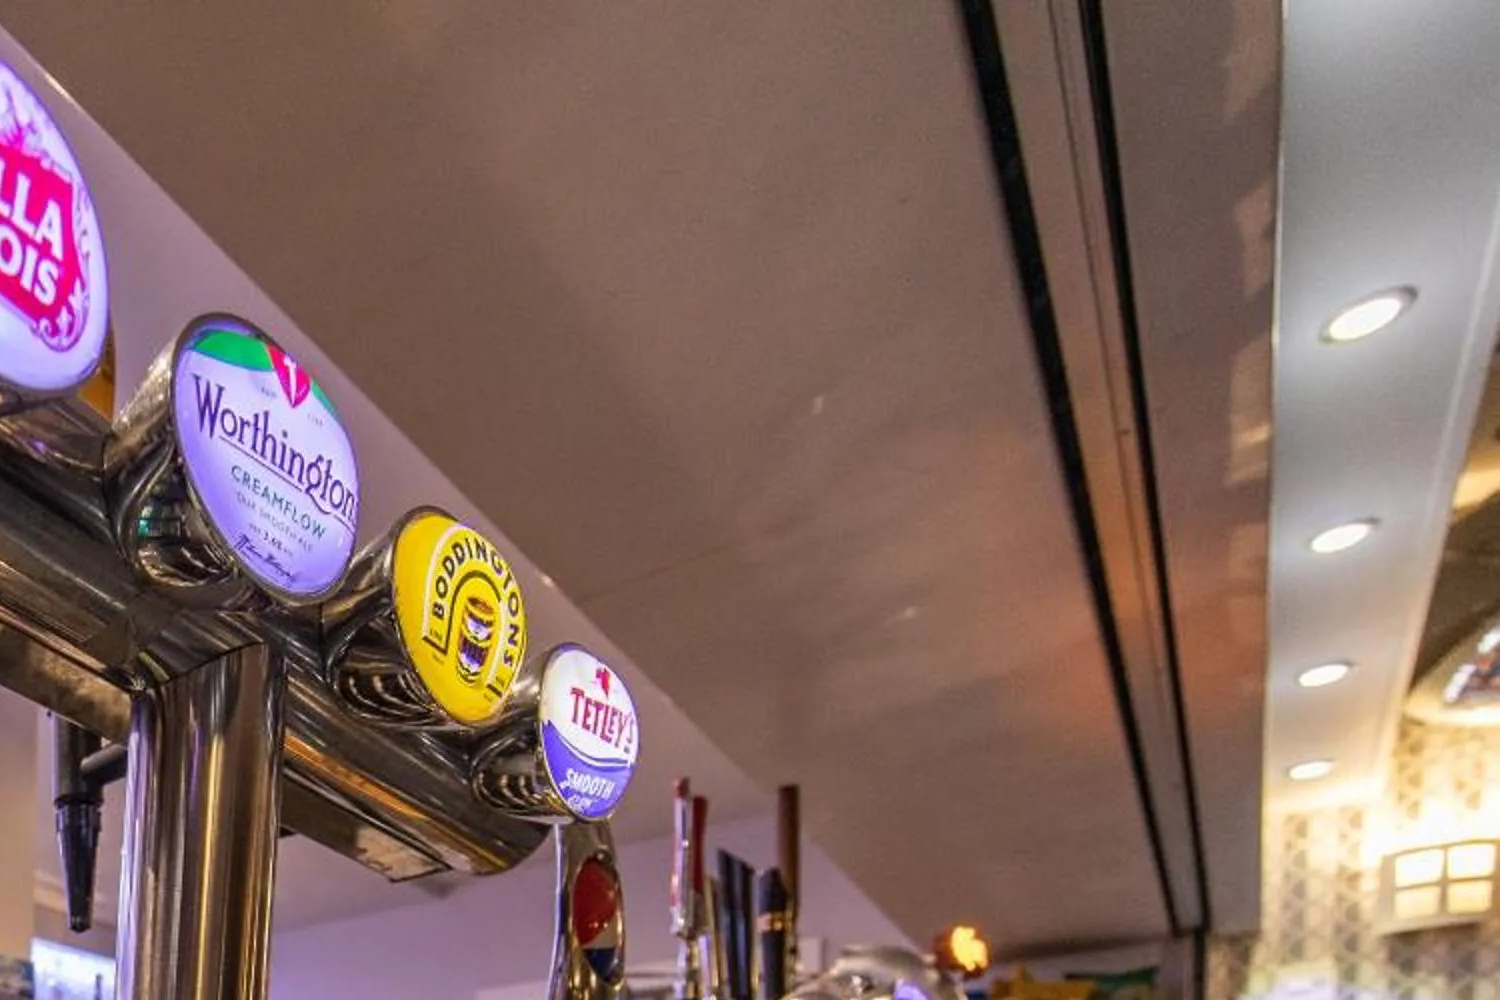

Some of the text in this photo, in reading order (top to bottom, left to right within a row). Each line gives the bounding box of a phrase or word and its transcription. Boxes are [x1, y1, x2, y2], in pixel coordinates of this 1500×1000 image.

[230, 464, 327, 540] CREAMFLOW
[432, 537, 520, 667] BODDINGTONS
[560, 768, 617, 799] SMOOTH
